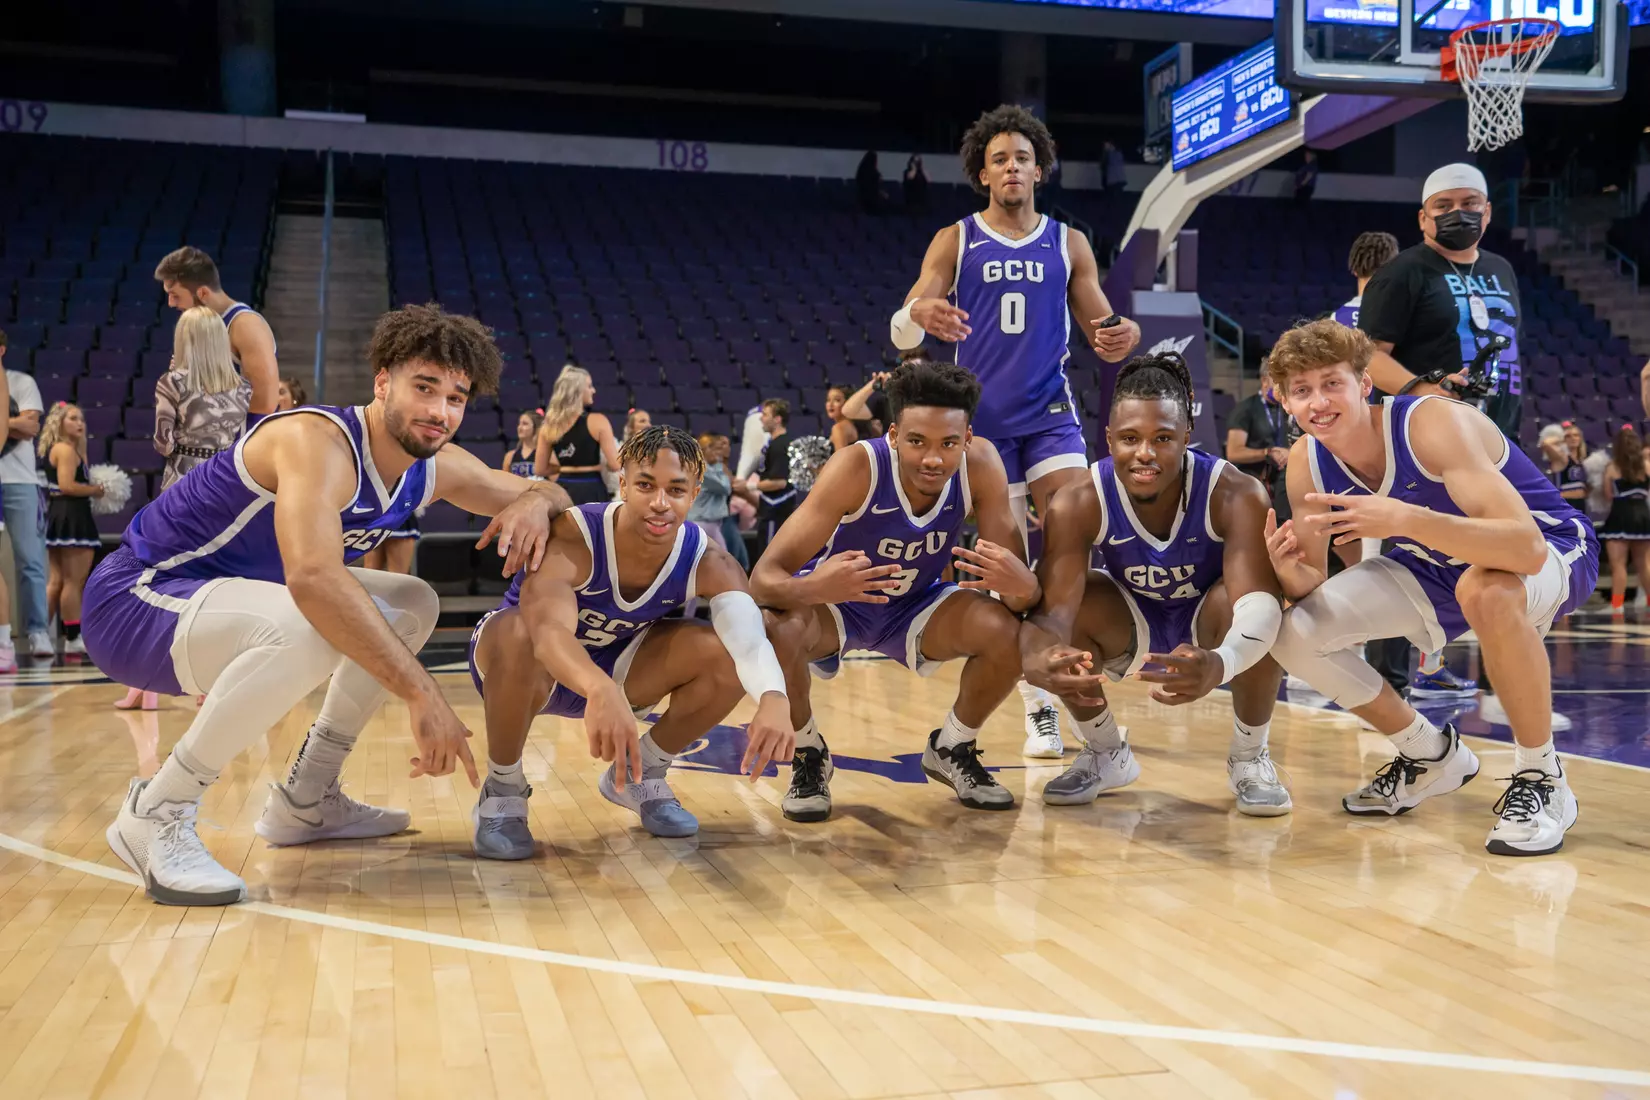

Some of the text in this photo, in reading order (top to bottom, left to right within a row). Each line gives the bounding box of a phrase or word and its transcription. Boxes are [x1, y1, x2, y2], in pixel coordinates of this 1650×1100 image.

[1260, 85, 1284, 112] GCU
[1199, 117, 1220, 142] GCU
[656, 139, 709, 171] 108
[982, 259, 1045, 284] GCU
[1443, 273, 1511, 297] BALL
[1000, 291, 1027, 335] 0
[876, 530, 949, 562] GCU
[1123, 564, 1197, 589] GCU
[578, 608, 655, 632] GC
